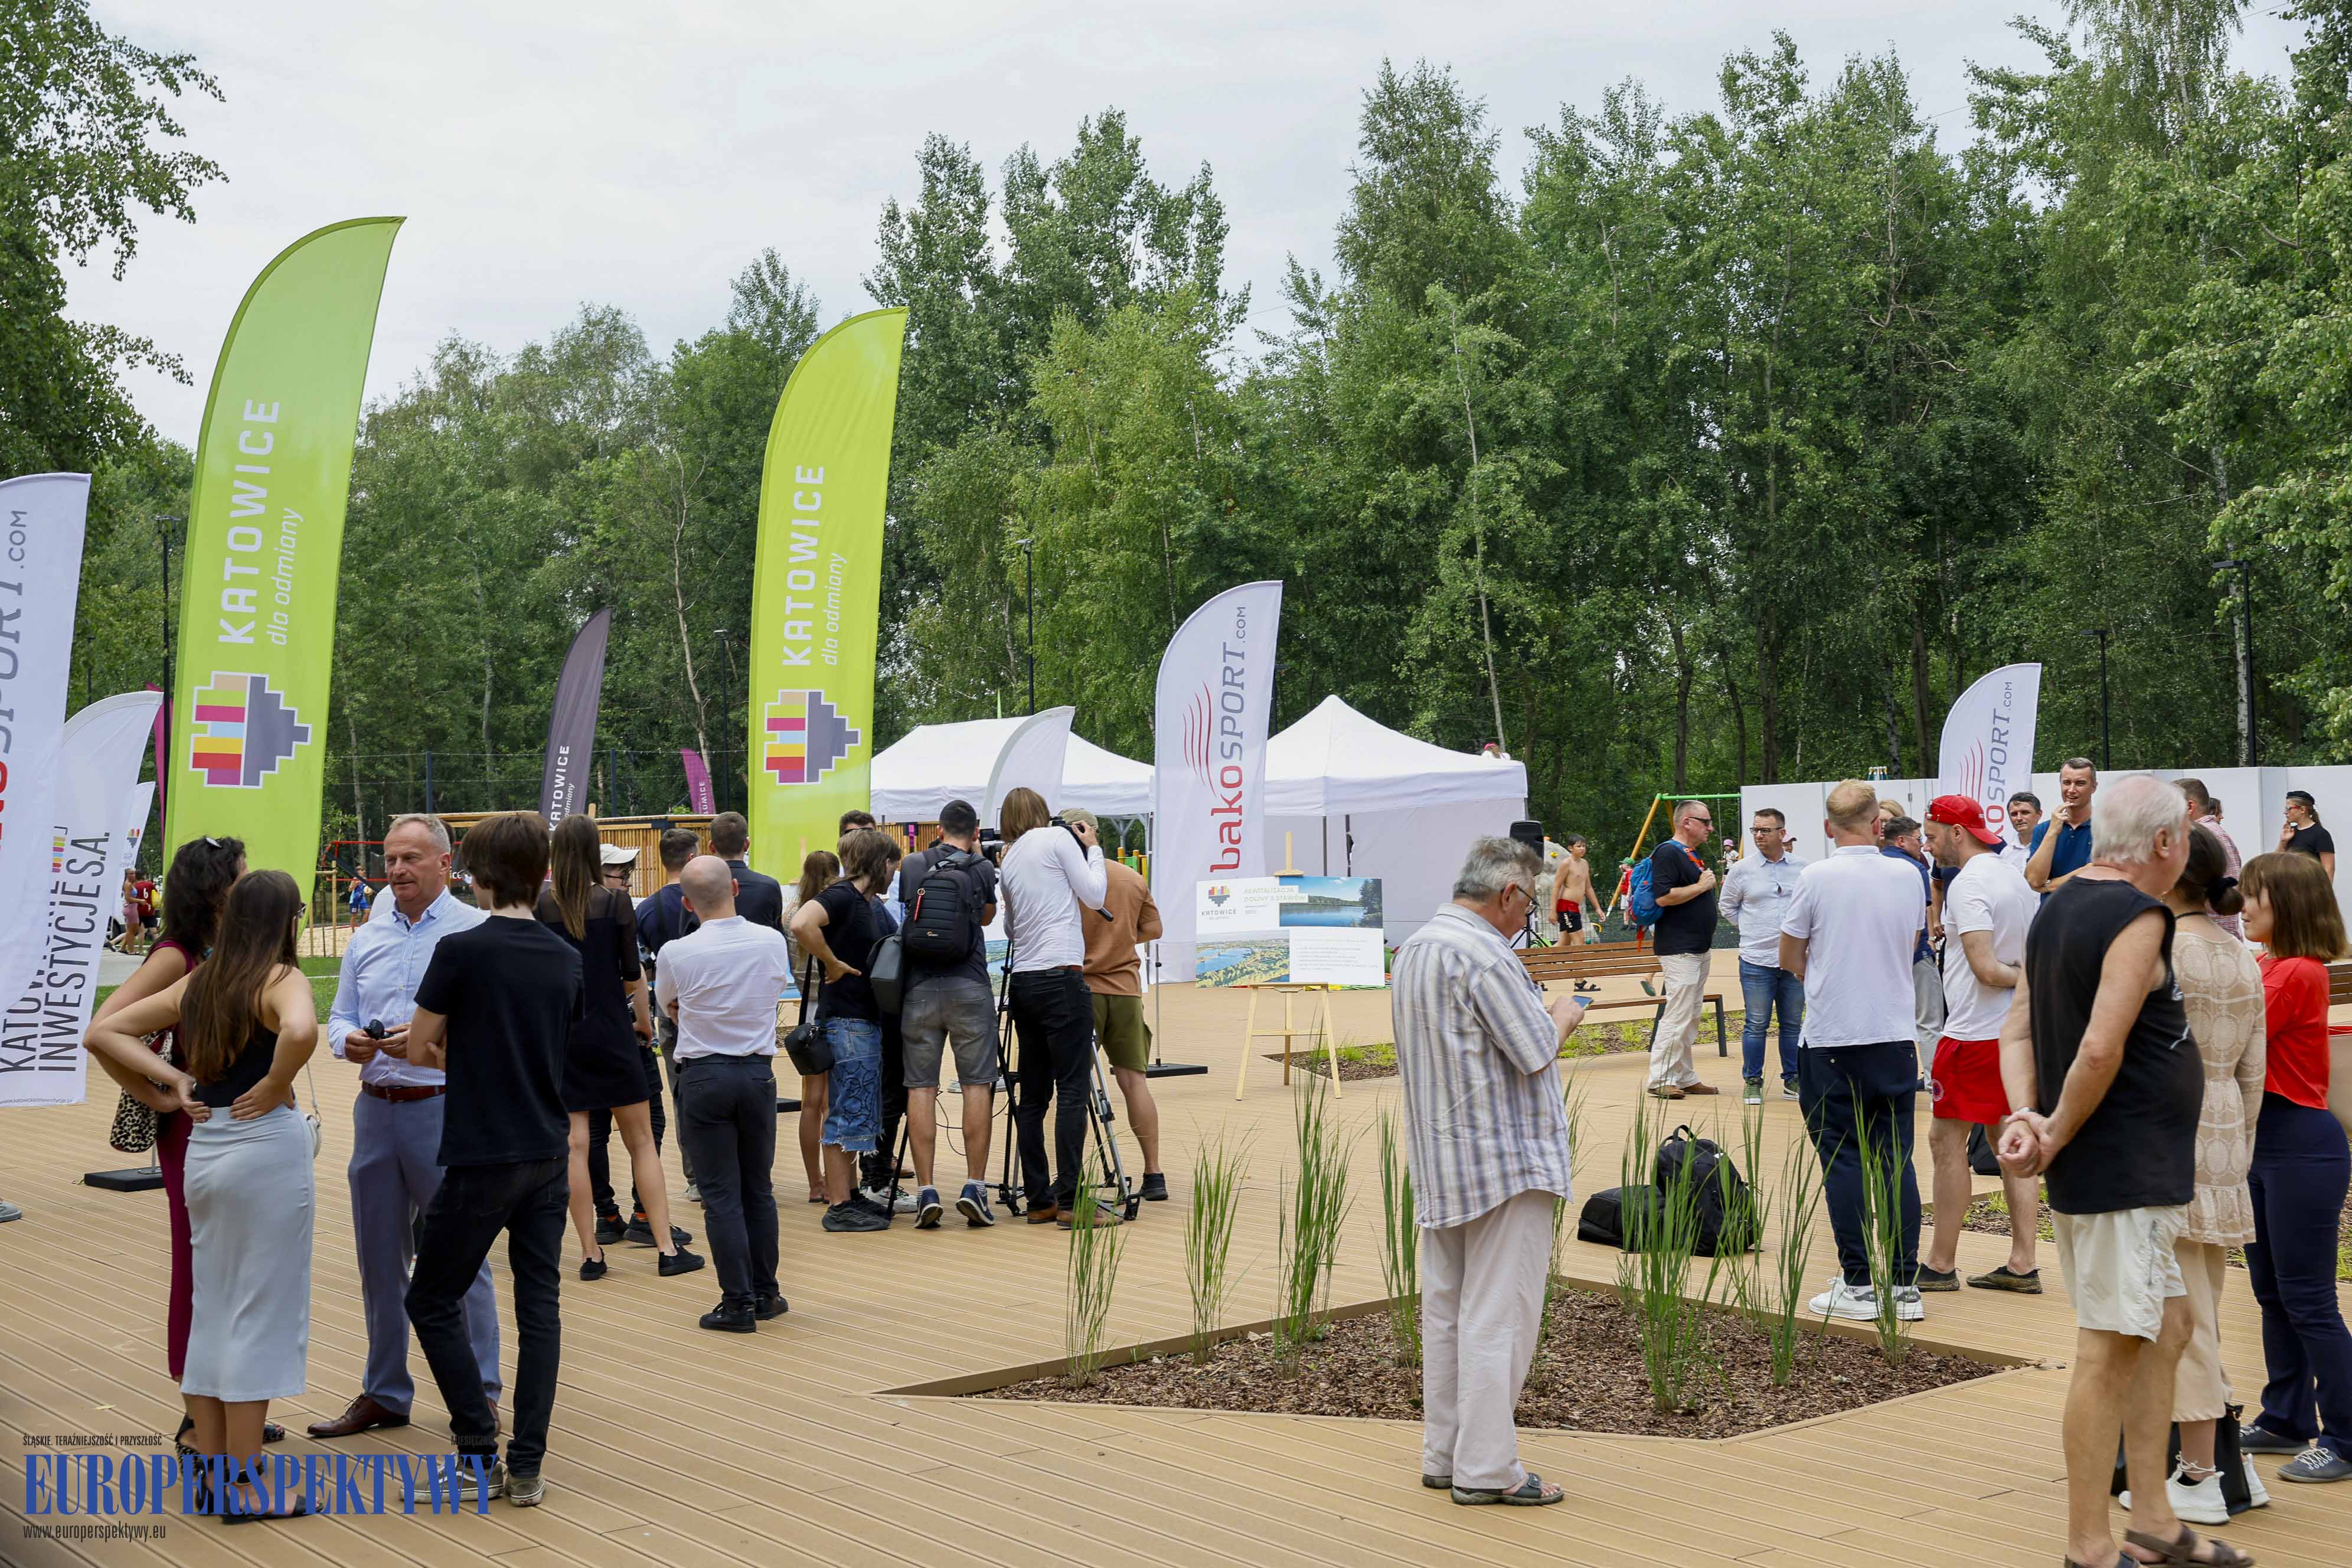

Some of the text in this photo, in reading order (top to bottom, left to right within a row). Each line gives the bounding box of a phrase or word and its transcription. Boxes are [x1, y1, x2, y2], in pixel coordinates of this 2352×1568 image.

[218, 398, 280, 644] KATOWICE
[266, 507, 304, 646] dla odmiany
[782, 465, 824, 666] KATOWICE
[821, 553, 848, 666] dla odmiany
[548, 746, 570, 832] KATOWICE
[38, 832, 110, 1072] INWESTYCJE S.A.
